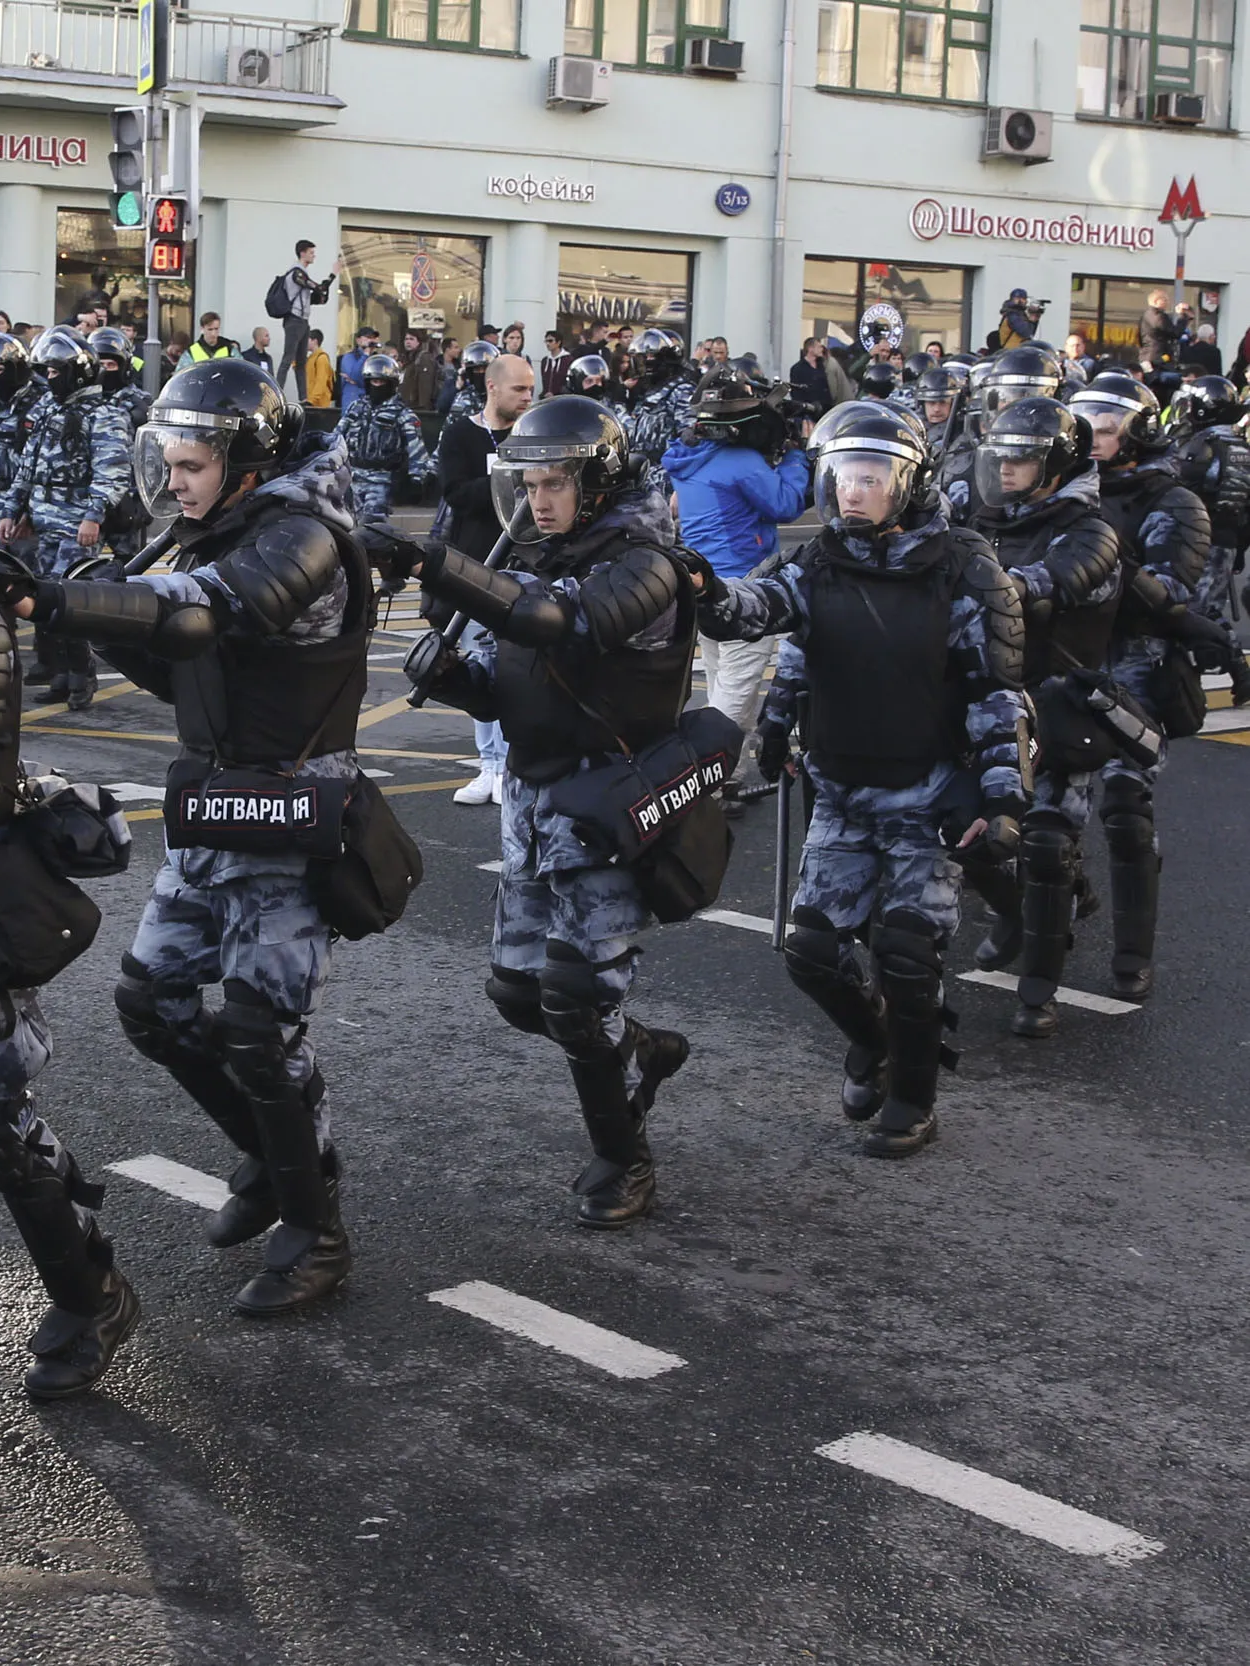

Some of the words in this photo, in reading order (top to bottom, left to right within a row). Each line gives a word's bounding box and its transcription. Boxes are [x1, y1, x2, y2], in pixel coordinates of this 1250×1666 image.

[488, 174, 595, 203] кофейня
[723, 191, 748, 206] 3/13
[948, 205, 1155, 252] Шоколадница
[154, 245, 180, 269] 81
